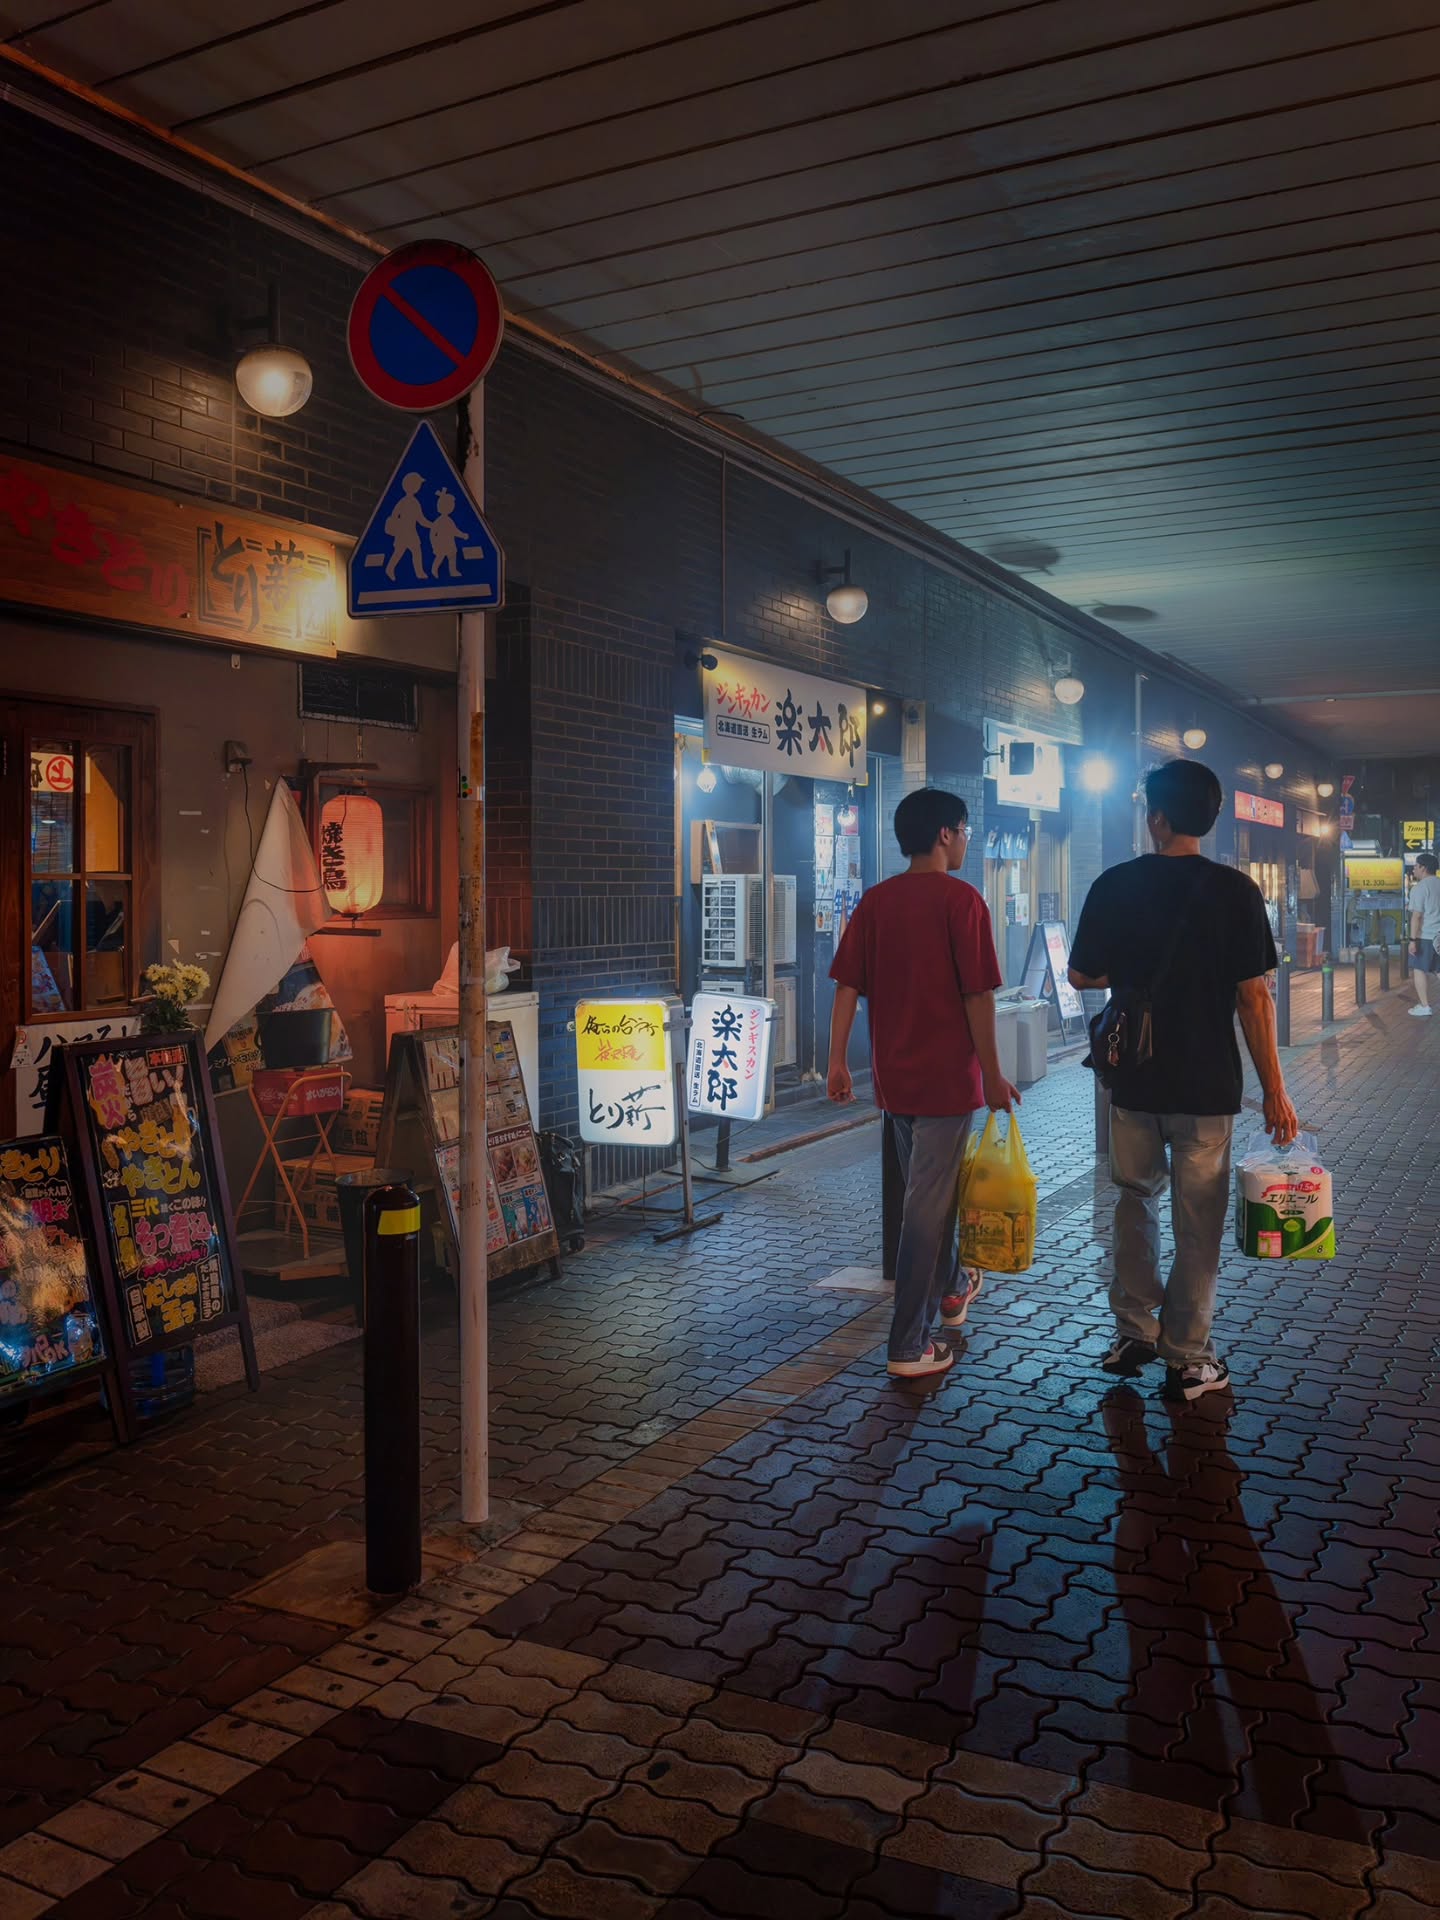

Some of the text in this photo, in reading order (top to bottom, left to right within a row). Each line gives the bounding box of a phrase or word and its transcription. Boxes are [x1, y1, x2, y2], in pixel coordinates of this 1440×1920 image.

[0, 468, 189, 616] やきとり
[716, 682, 771, 719] ジンギスカン
[751, 726, 768, 739] 生ラム
[775, 688, 861, 768] 楽太郎
[707, 1004, 744, 1111] 楽太郎
[744, 1008, 761, 1080] ジンギスカン
[88, 1061, 125, 1129] 炭火
[0, 1145, 60, 1182] きとり
[121, 1155, 201, 1197] やきとん
[1266, 1194, 1319, 1205] エリエール
[135, 1211, 212, 1256] もつ煮込
